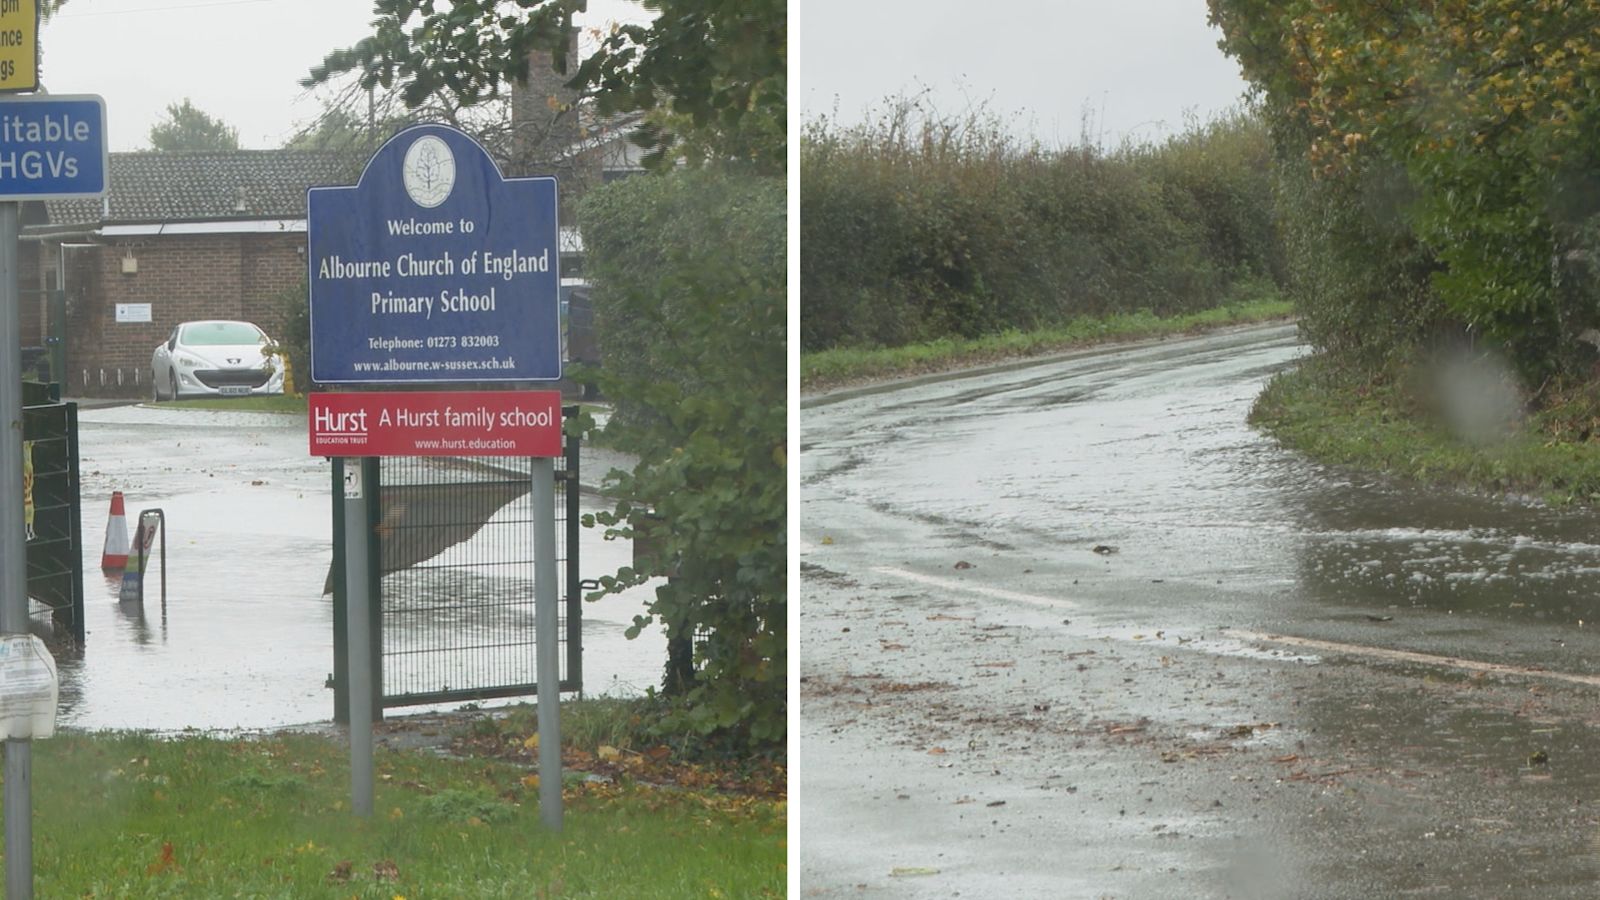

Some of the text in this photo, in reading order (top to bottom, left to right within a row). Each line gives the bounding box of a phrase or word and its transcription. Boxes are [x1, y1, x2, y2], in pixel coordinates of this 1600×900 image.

[3, 114, 89, 142] itable
[0, 151, 79, 179] HGVs
[387, 218, 475, 236] Welcome to
[319, 248, 549, 281] Albourne Church of England
[371, 287, 496, 320] Primary School
[368, 335, 500, 352] Telephone: 01273 832003
[353, 357, 516, 372] www.albourne.w-sussex.sch.uk
[315, 406, 368, 431] Hurst
[378, 406, 553, 432] A Hurst family school
[315, 437, 368, 445] EDUCATION TRUST
[415, 438, 516, 450] www.hurst.education
